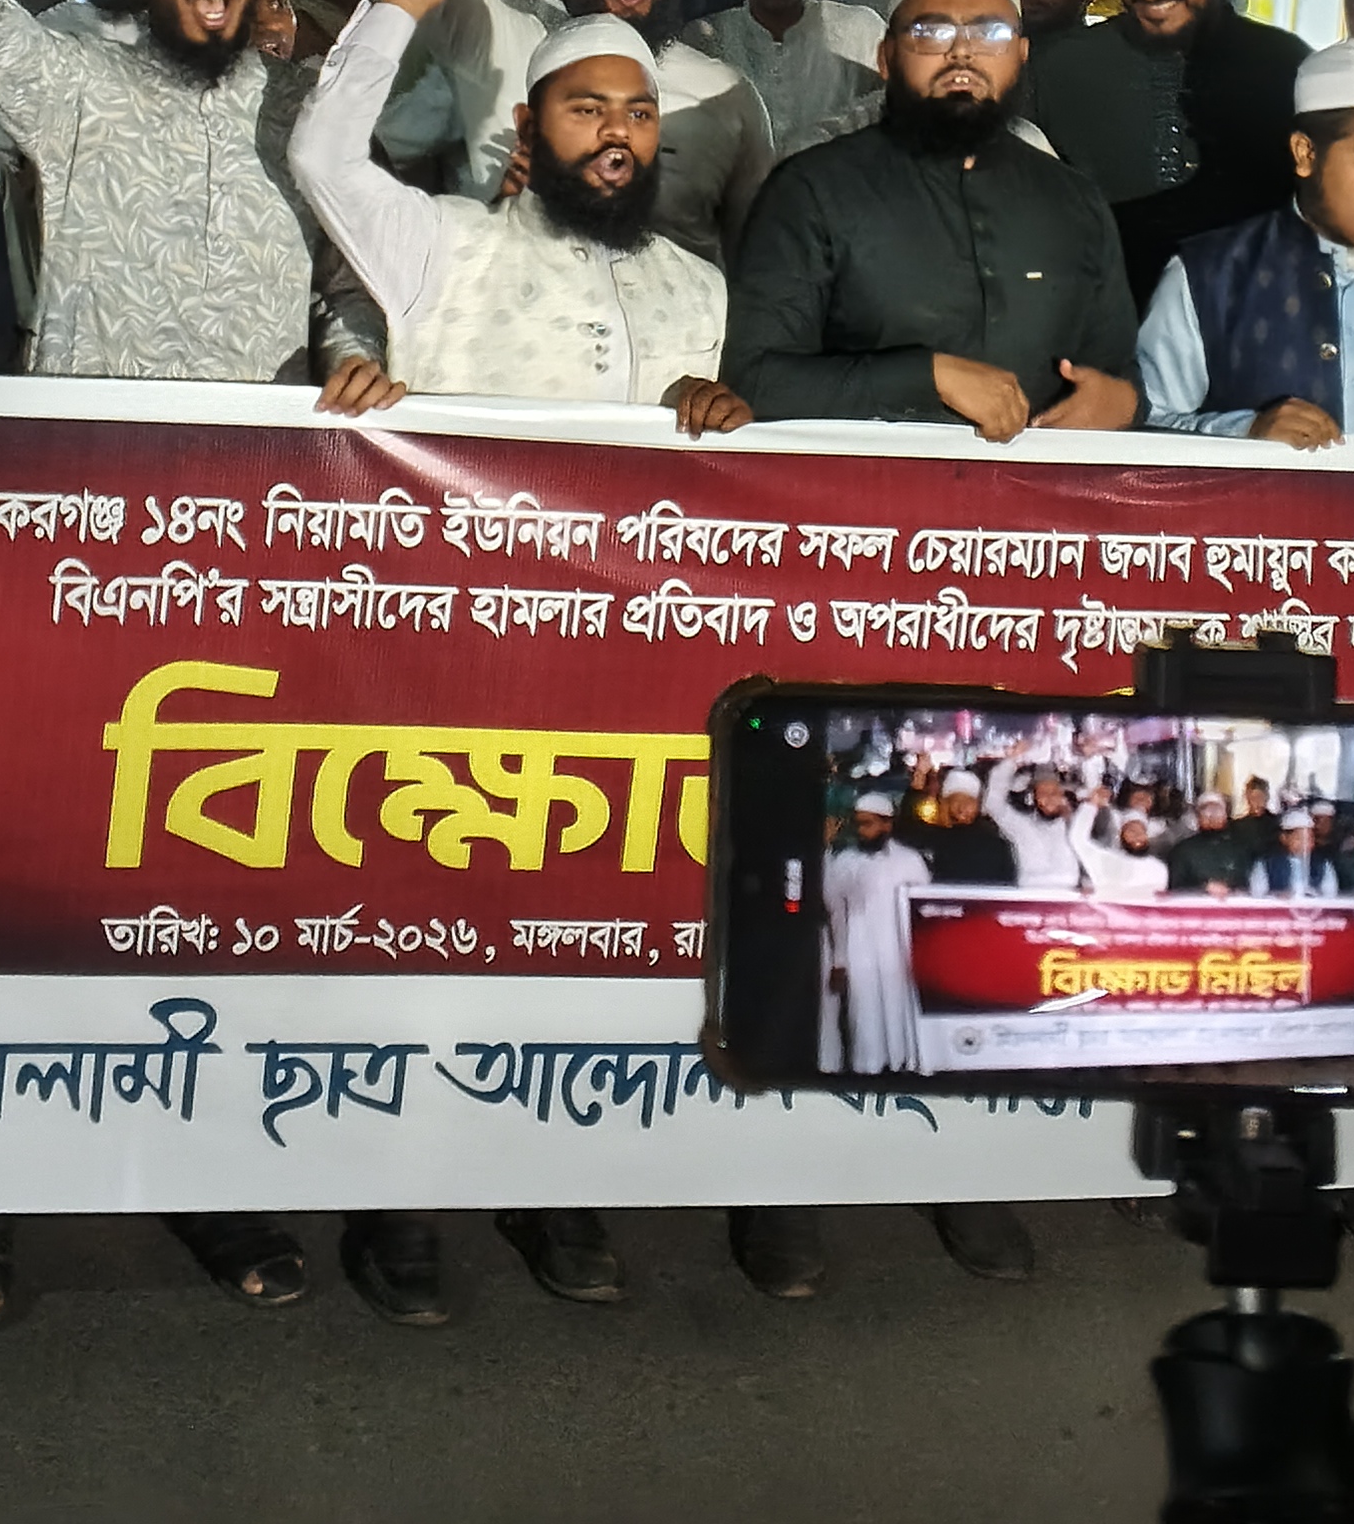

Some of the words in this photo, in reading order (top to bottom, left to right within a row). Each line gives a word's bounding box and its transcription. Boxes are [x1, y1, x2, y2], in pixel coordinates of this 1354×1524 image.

[141, 495, 247, 553] ১৪নং
[261, 484, 432, 554] নিয়ামতি
[441, 490, 604, 563] ইউনিয়ন
[616, 498, 790, 569] পরিষদের
[796, 524, 900, 573] সফল
[907, 526, 1090, 581] চেয়ারম্যান
[1097, 531, 1197, 585] জনাব
[1203, 533, 1318, 596] হুমায়ুন
[259, 562, 460, 634] সন্ত্রাসীদের
[468, 583, 615, 640] হামলার
[622, 578, 777, 646] প্রতিবাদ
[787, 600, 817, 644] ও
[829, 586, 1044, 653] অপরাধীদের
[1052, 593, 1232, 675] দৃষ্টান্তমক
[232, 917, 280, 955] ১০
[510, 917, 659, 966] মঙ্গলবার,
[672, 919, 708, 960] রা
[1038, 947, 1192, 999] বিক্ষোভ
[1196, 948, 1312, 1000] মিছিল
[244, 1038, 430, 1149] ছাত্র
[416, 1040, 793, 1131] আন্দোল
